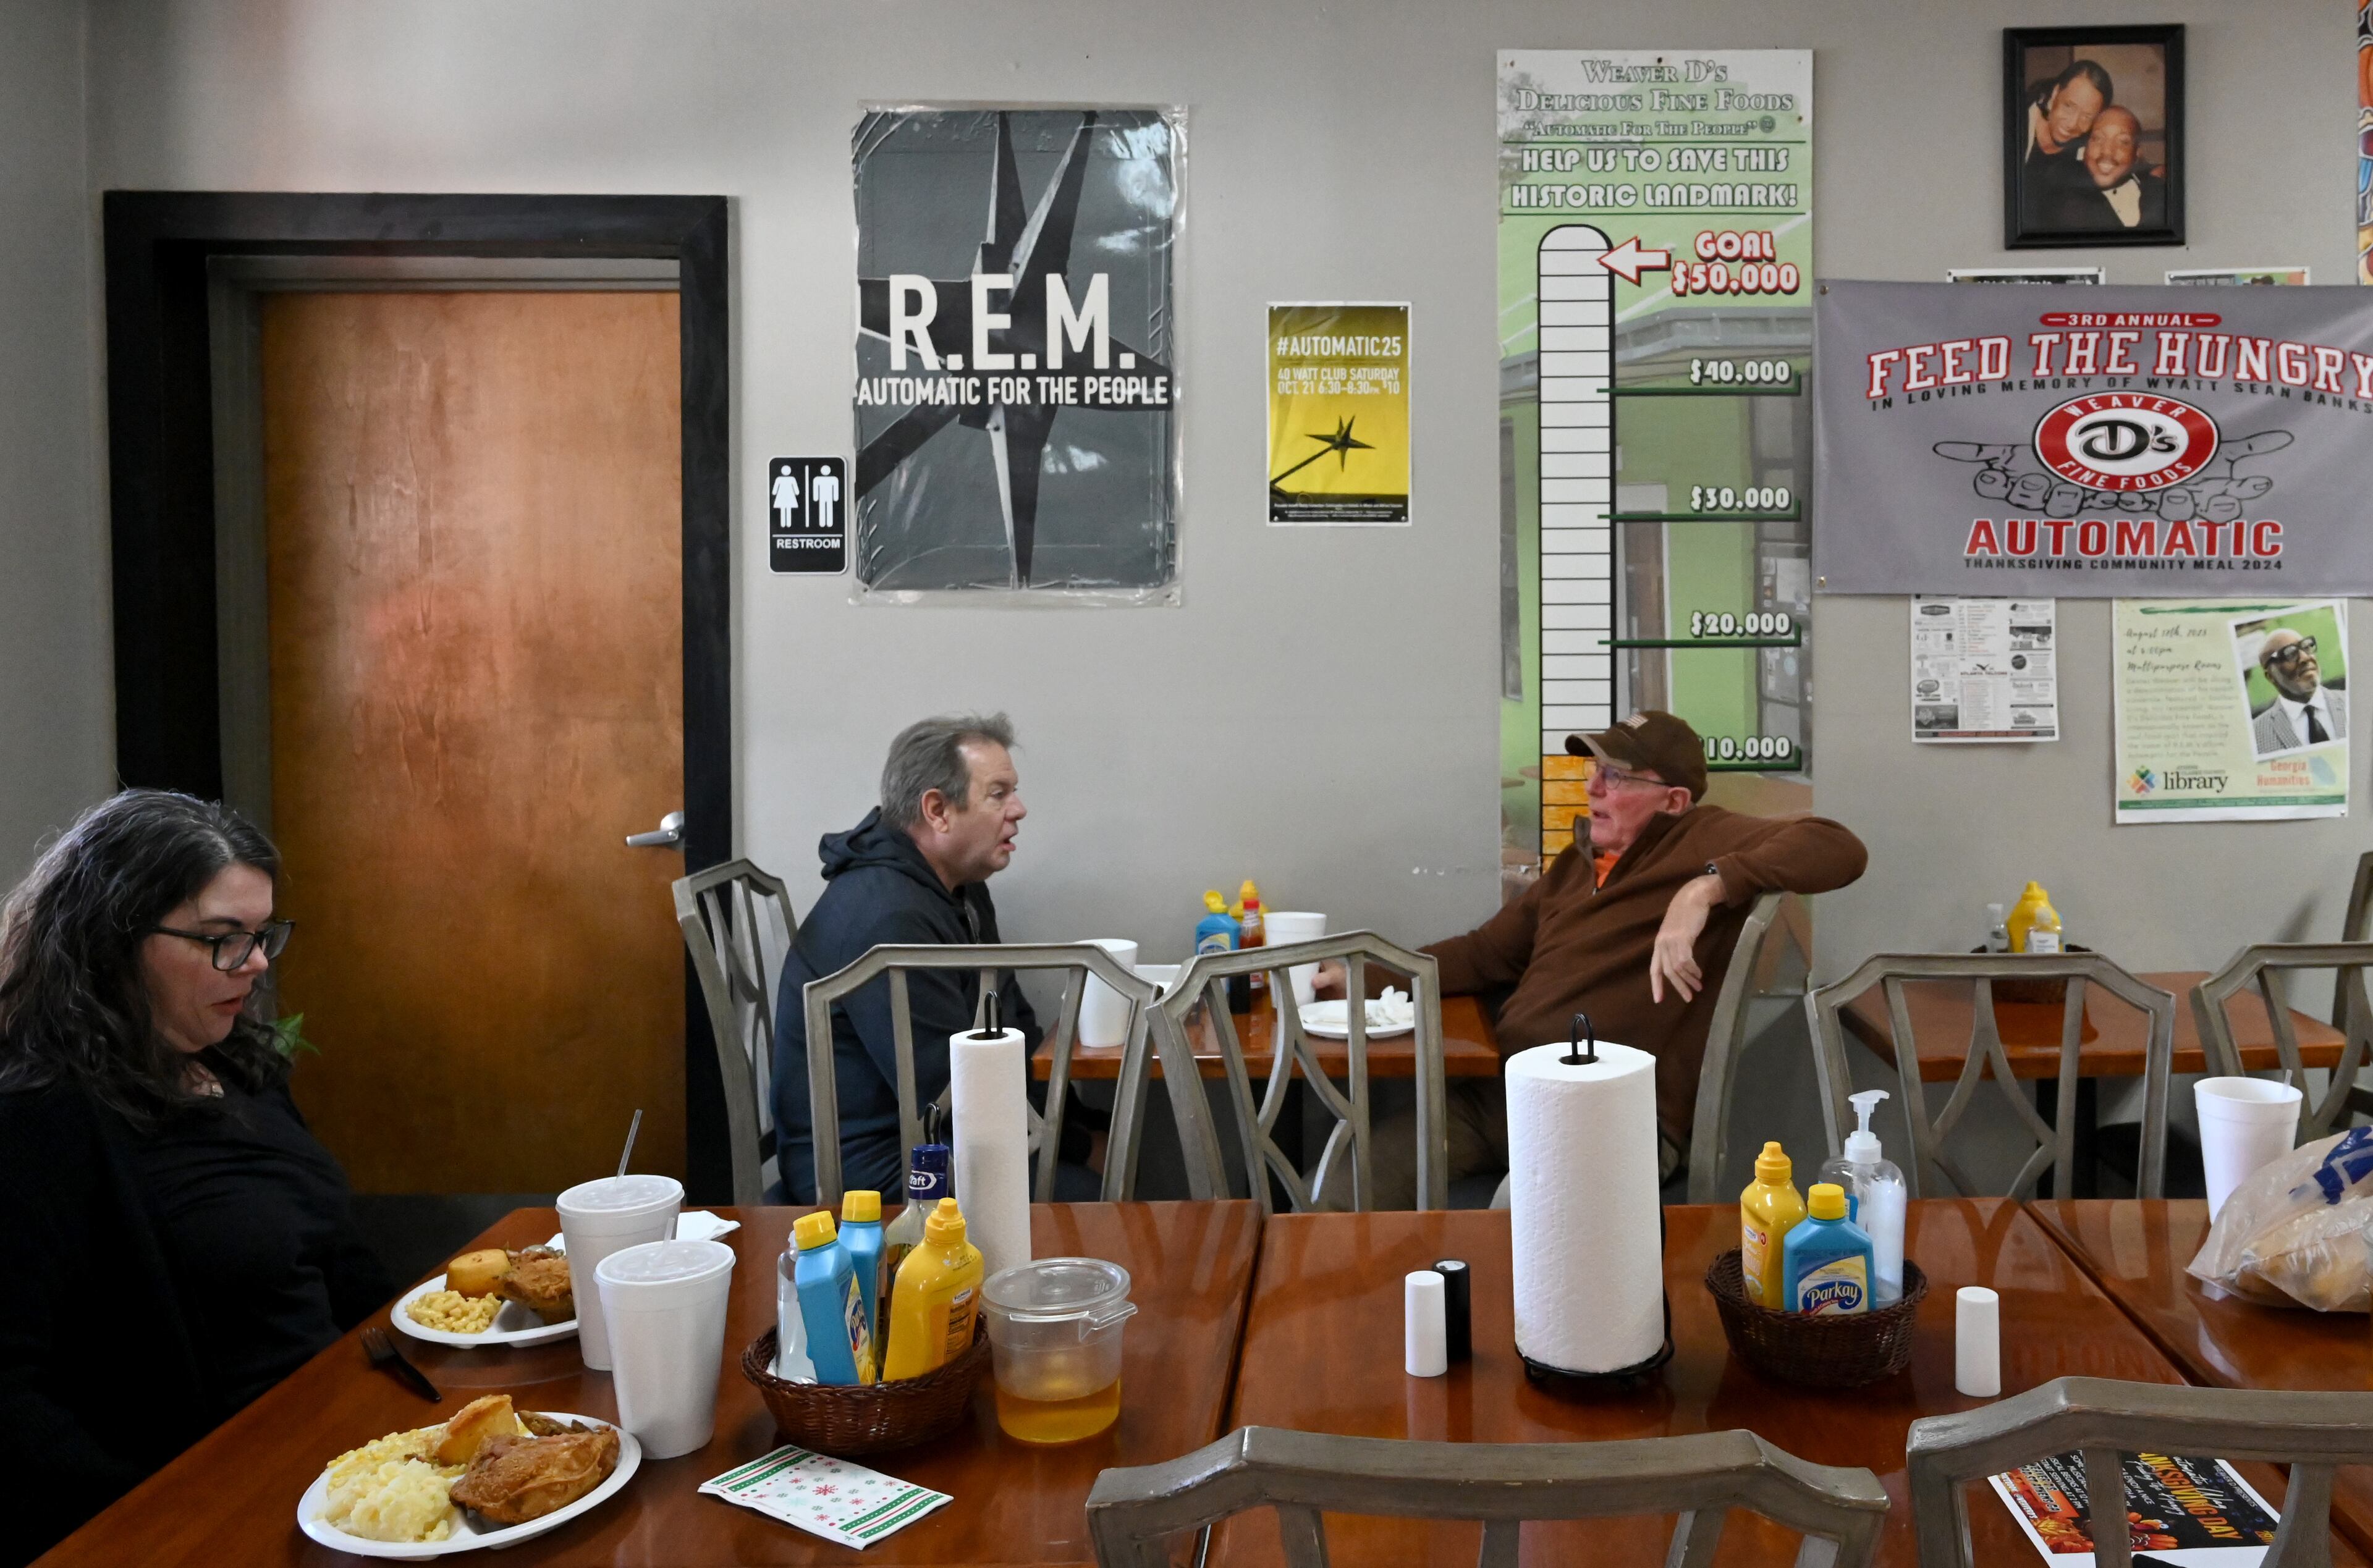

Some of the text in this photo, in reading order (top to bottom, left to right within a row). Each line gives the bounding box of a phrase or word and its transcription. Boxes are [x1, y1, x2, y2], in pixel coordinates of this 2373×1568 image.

[1521, 148, 1789, 174] HELP US TO SAVE THIS
[1511, 184, 1797, 208] HISTORIC LANDMARK!
[1694, 230, 1775, 261] GOAL
[889, 273, 1135, 370] R.E.M.
[2068, 314, 2193, 326] 3RD ANNUAL
[1277, 336, 1402, 356] #AUTOMATIC25
[1277, 368, 1400, 381] 40 WATT CLUB SATURDAY
[1866, 331, 2373, 400] FEED THE HUNGRY
[858, 376, 1168, 406] AUTOMATIC FOR THE PEOPLE
[1302, 381, 1314, 394] 21
[1872, 376, 2373, 414] IN LOVING MEMORY OF WYATT SEAN BANKS
[2064, 395, 2188, 418] WEAVER
[2057, 460, 2193, 489] FINE FOODS
[777, 538, 840, 549] RESTROOM
[1964, 518, 2283, 557] AUTOMATIC
[1965, 558, 2283, 571] THANKSGIVING COMMUNITY MEAL 2024
[2270, 760, 2307, 773] Georgia
[2164, 771, 2228, 793] library
[1807, 1281, 1859, 1307] Parkay
[2052, 1471, 2071, 1490] SERVING
[2073, 1500, 2084, 1509] PM
[2138, 1452, 2243, 1540] ANKSGIVING DAY
[2139, 1493, 2155, 1504] NICE
